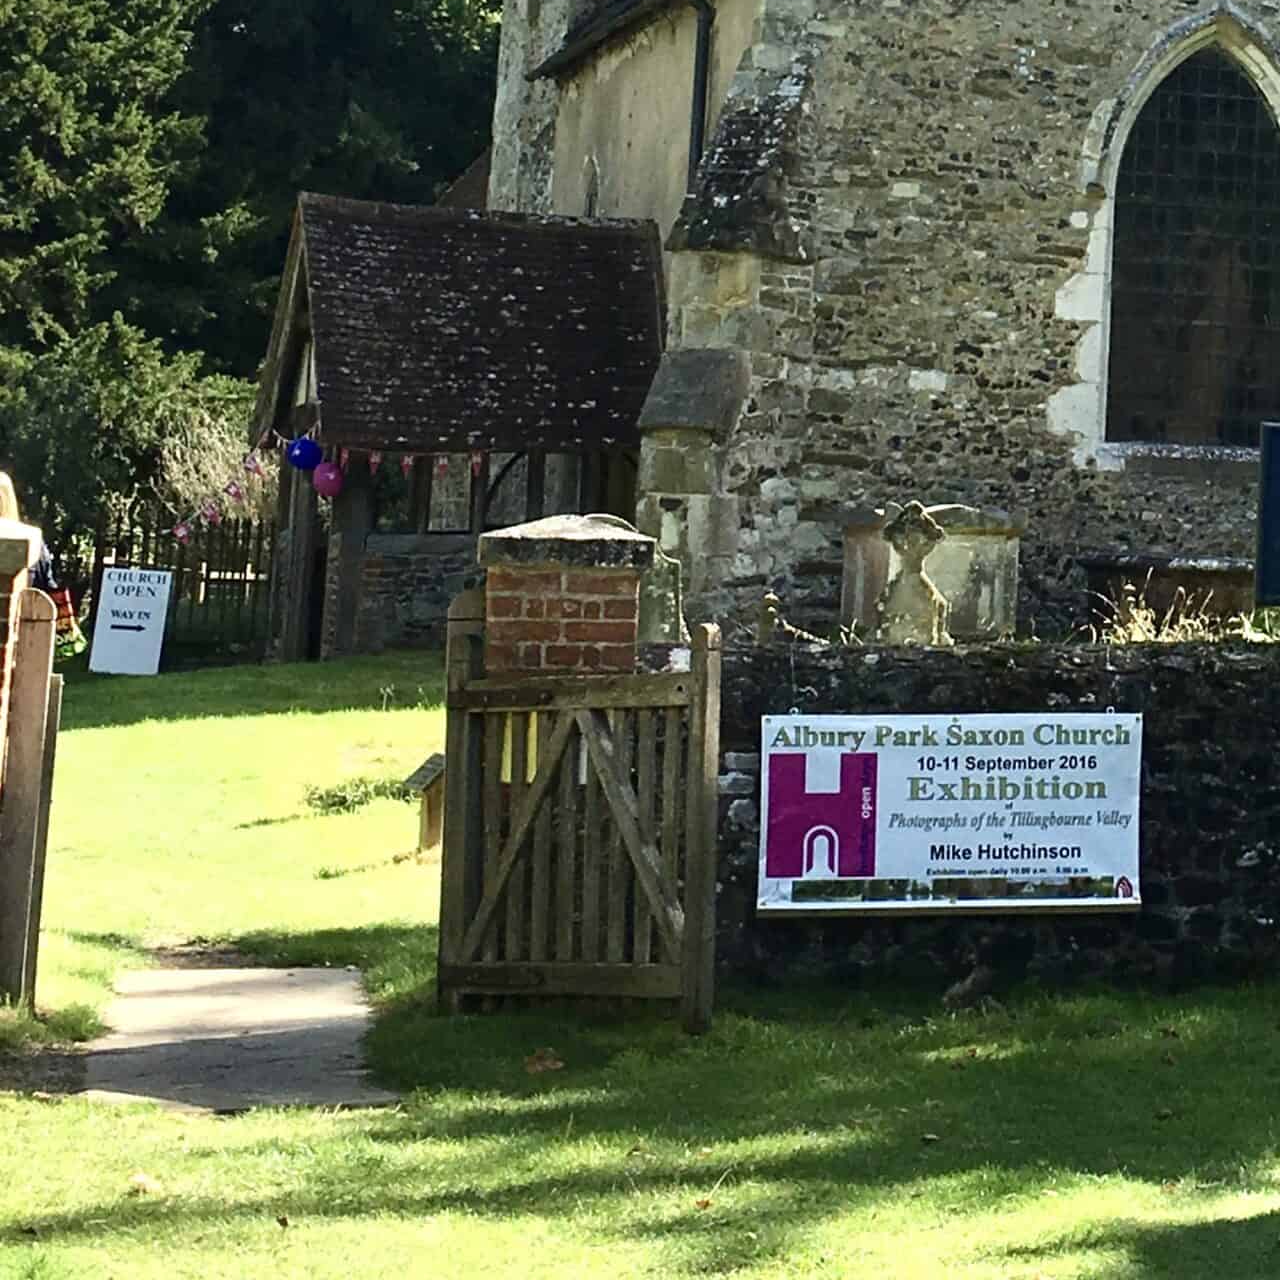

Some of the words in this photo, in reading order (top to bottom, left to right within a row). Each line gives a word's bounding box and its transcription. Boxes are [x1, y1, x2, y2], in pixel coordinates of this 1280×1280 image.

[107, 570, 167, 584] CHURCH
[113, 584, 156, 597] OPEN
[110, 609, 136, 620] WAY
[137, 610, 151, 621] IN
[770, 724, 866, 753] Albury
[873, 724, 940, 747] Park
[945, 723, 1026, 747] Saxon
[1032, 722, 1131, 746] Church
[916, 755, 959, 771] 10-11
[964, 755, 1055, 774] September
[1058, 754, 1098, 770] 2016
[906, 776, 1108, 802] Exhibition
[861, 786, 873, 819] open
[888, 812, 967, 832] Photographs
[970, 811, 987, 832] of
[986, 810, 1006, 828] the
[1009, 810, 1092, 831] Tillingbourne
[1095, 809, 1132, 829] Valley
[929, 844, 973, 861] Mike
[977, 842, 1082, 860] Hutchinson
